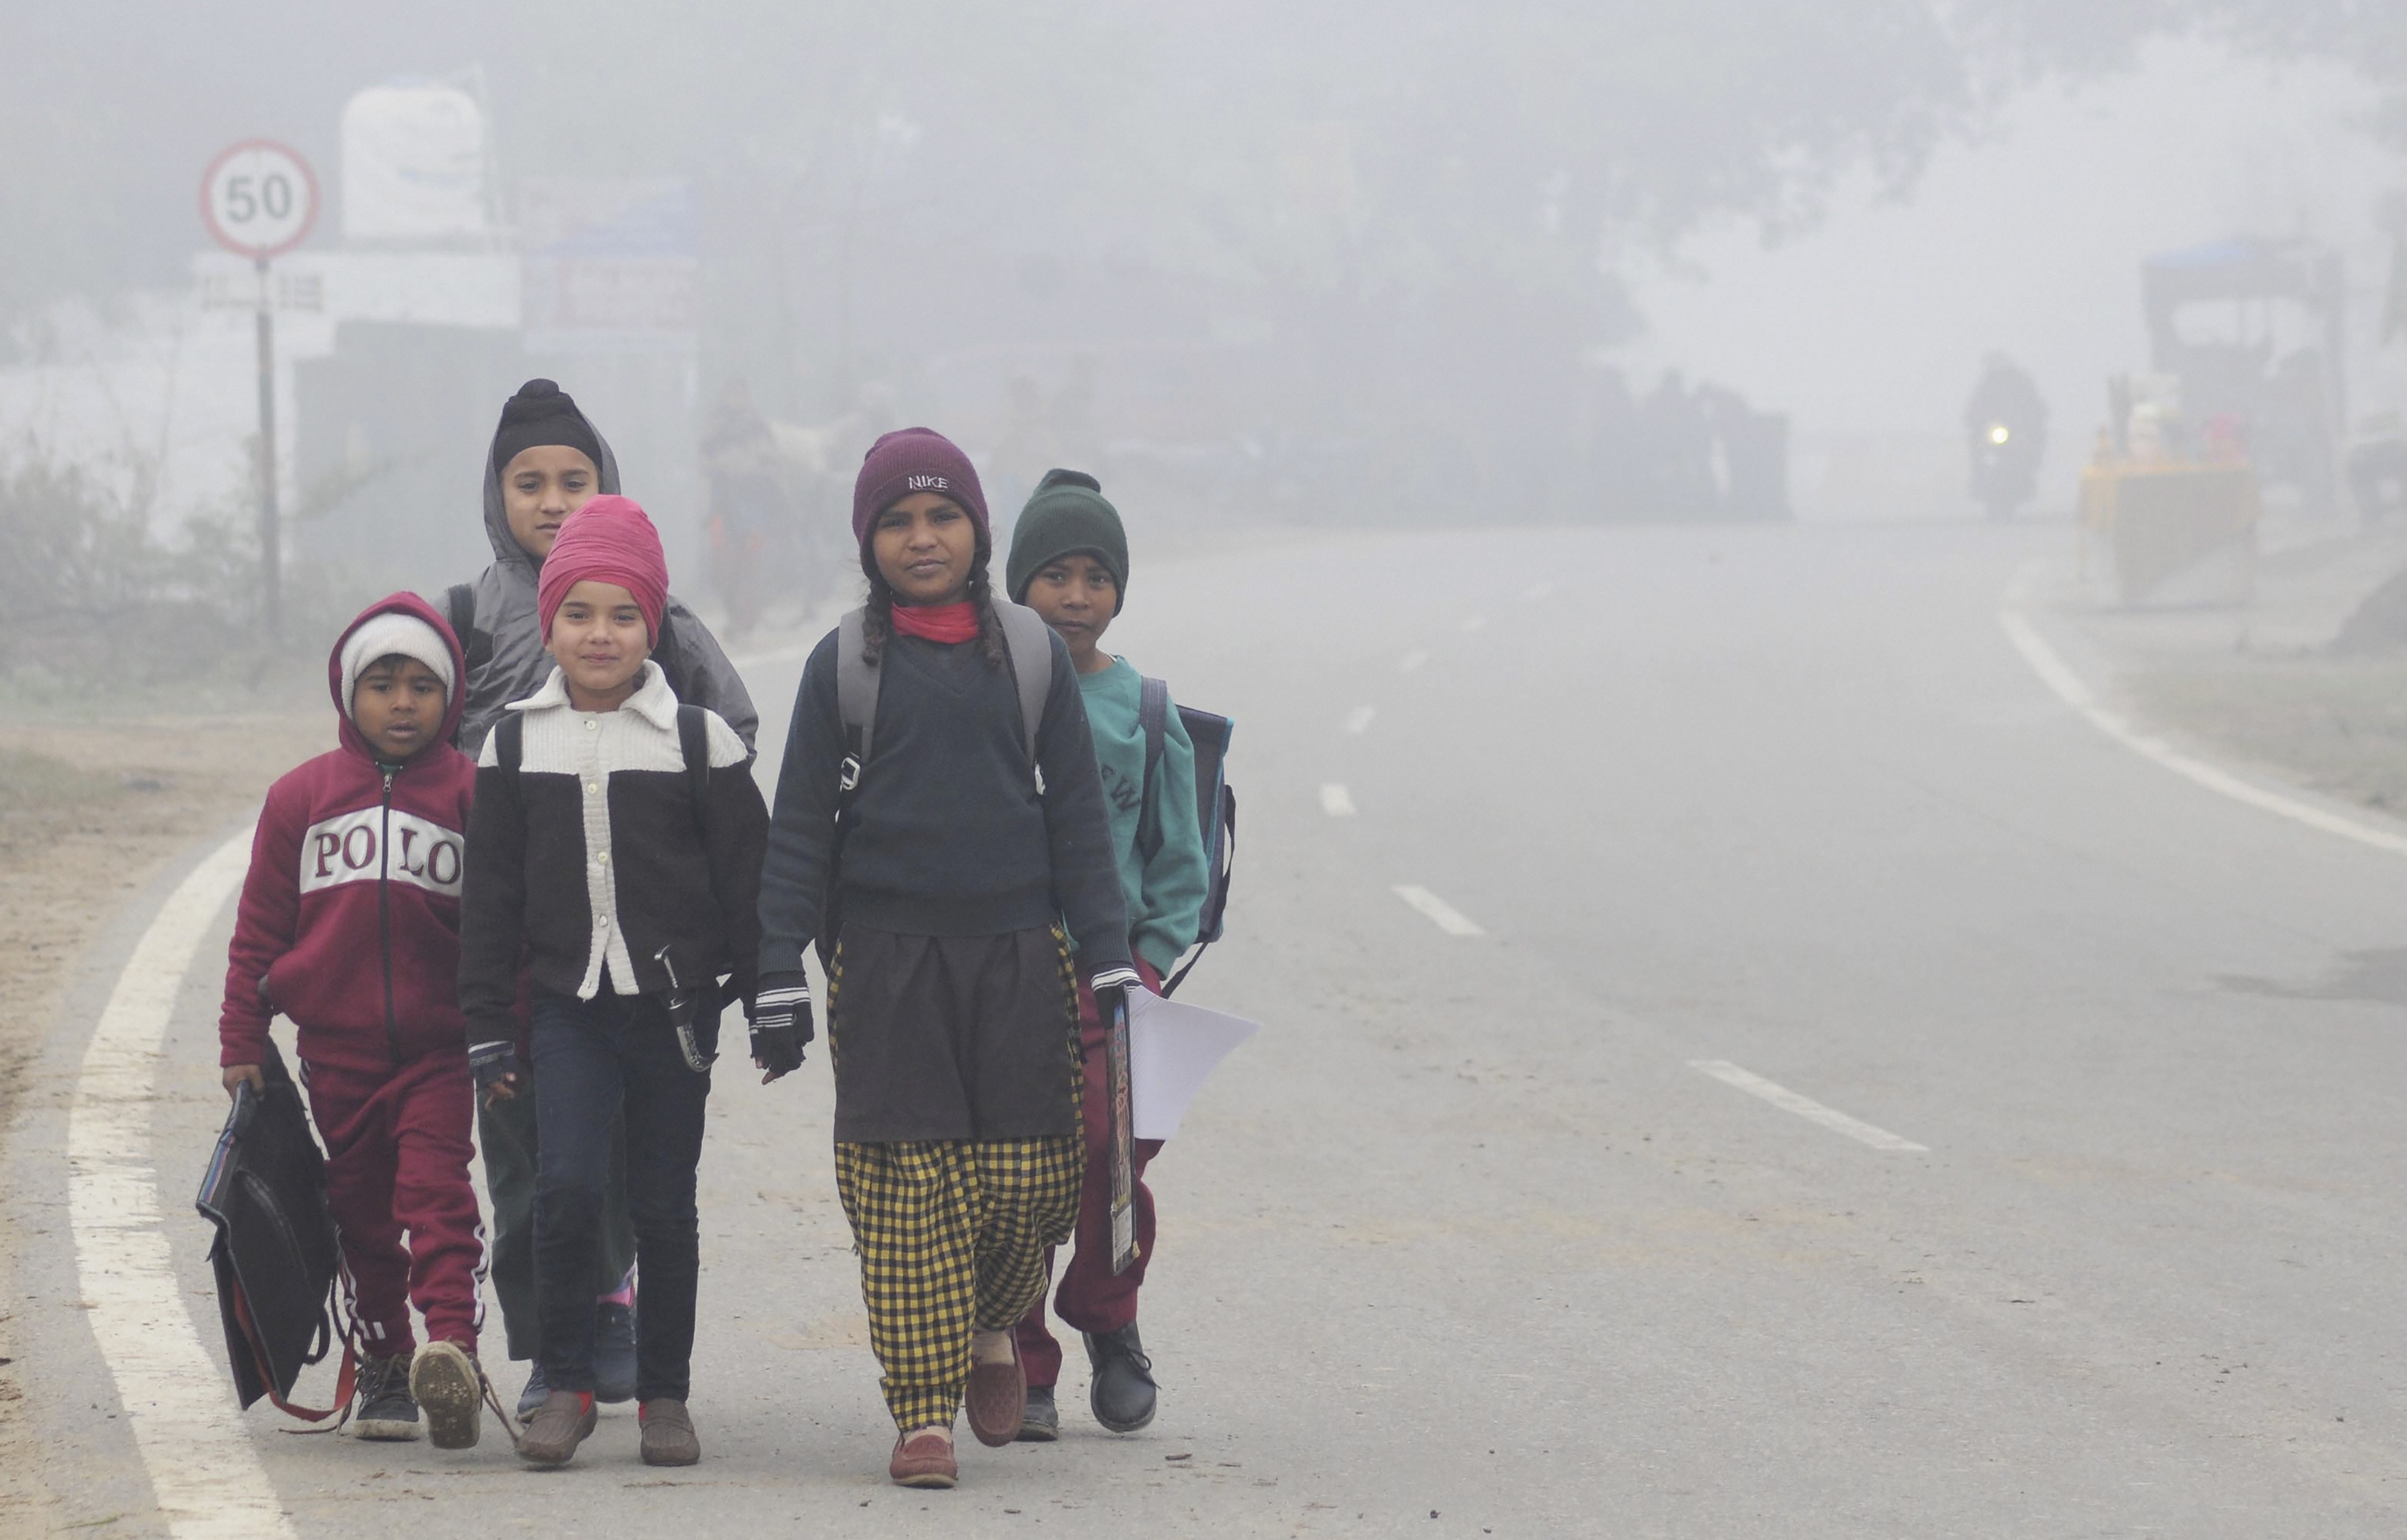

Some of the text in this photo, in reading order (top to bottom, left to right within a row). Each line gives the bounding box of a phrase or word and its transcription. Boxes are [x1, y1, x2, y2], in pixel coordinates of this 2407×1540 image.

[227, 172, 292, 224] 50
[908, 475, 948, 489] NIKE
[315, 825, 461, 885] POLO
